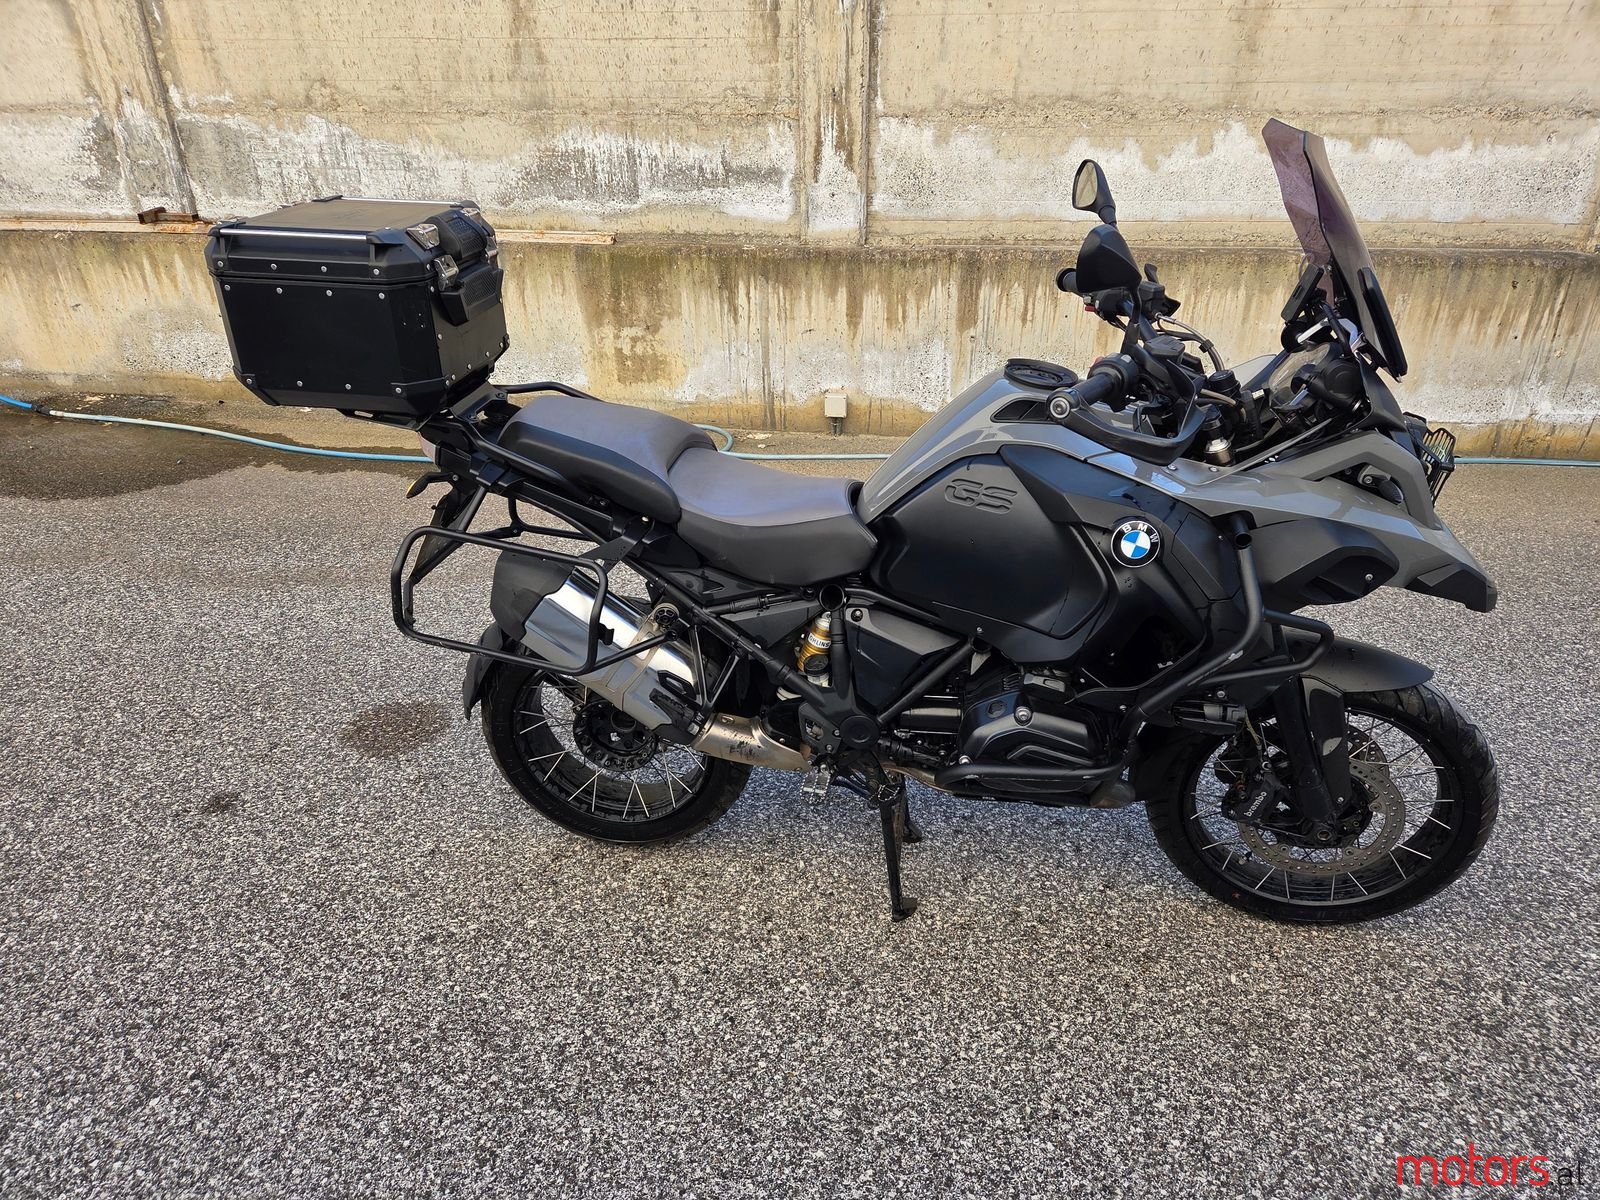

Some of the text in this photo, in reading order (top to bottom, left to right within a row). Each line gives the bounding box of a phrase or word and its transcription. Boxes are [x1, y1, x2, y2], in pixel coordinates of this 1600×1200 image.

[944, 478, 1018, 515] GS
[1121, 522, 1159, 543] BMW
[1243, 791, 1267, 817] brembo
